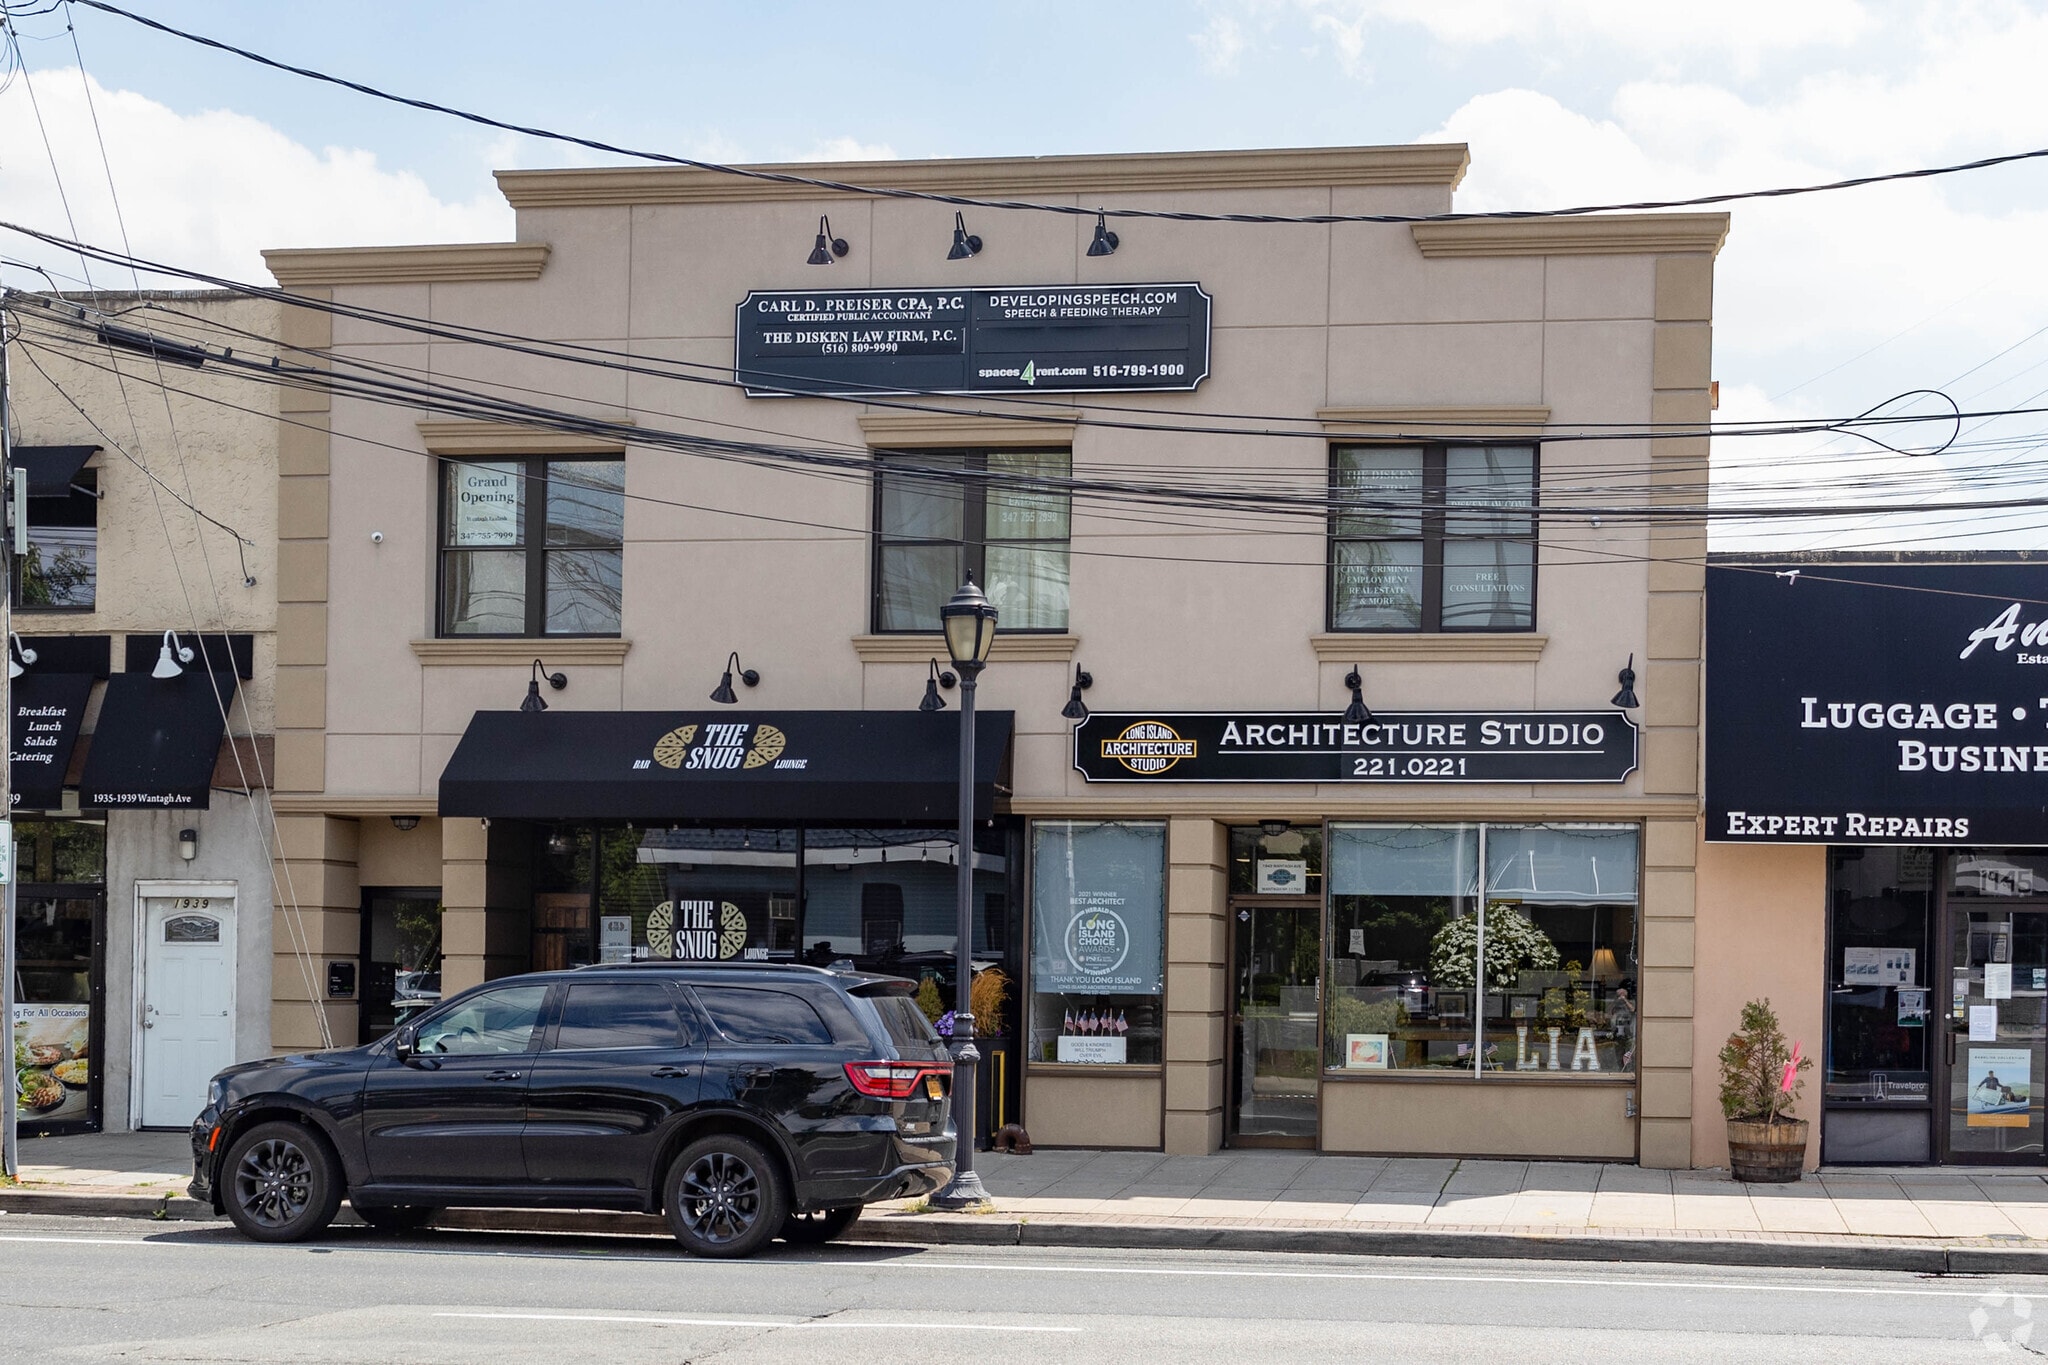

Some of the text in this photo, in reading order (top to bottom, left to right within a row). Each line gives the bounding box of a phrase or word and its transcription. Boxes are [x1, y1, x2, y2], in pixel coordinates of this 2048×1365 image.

[758, 297, 965, 313] CARL D. PREISER CPA, P.C.
[989, 292, 1177, 307] DEVELOPINGSPEECH.COM
[787, 311, 933, 322] CERTIFIED PUBLIC ACCOUNTANT
[1004, 306, 1163, 318] SPEECH & FEEDING THERAPY
[763, 330, 957, 344] THE DISKEN LAW FIRM, P.C.
[822, 342, 898, 354] (516) 809-9990
[1093, 364, 1184, 377] 516-799-1900
[468, 475, 507, 488] Grand
[461, 491, 515, 505] Opening
[460, 532, 514, 540] 347-755-7999
[1371, 565, 1414, 573] CRIMINAL
[1475, 573, 1500, 581] FREE
[1449, 584, 1525, 592] CONSULTATIONS
[17, 706, 67, 717] Breakfast
[1801, 697, 1998, 730] LUGGAGE
[28, 722, 62, 731] Lunch
[1126, 724, 1173, 739] LONG ISLAND
[703, 724, 749, 747] THE
[1219, 720, 1605, 746] ARCHITECTURE STUDIO
[24, 736, 58, 746] Salads
[1105, 742, 1193, 755] ARCHITECTURE
[8, 752, 54, 763] Catering
[685, 747, 745, 769] SNUG
[632, 759, 808, 769] BAR LOUNGE
[1130, 758, 1166, 771] STUDIO
[1353, 758, 1467, 777] 221.0221
[93, 794, 192, 805] 1935-1939 Wantagh Ave
[1727, 811, 1969, 838] EXPERT REPAIRS
[174, 898, 209, 909] 1939
[681, 900, 714, 929] THE
[1085, 906, 1110, 914] HERALD
[1078, 919, 1116, 930] LONG
[1078, 930, 1116, 938] ISLAND
[676, 930, 717, 960] SNUG
[1078, 938, 1116, 946] CHOICE
[635, 947, 769, 960] BAR LOUNGE
[1078, 945, 1116, 953] AWARDS
[1084, 967, 1111, 976] WINNER
[1091, 976, 1113, 984] LONG
[1114, 976, 1142, 984] ISLAND
[23, 1009, 35, 1017] For
[51, 1009, 87, 1017] Occasions
[1516, 1026, 1600, 1071] LIA
[1887, 1082, 1925, 1091] Travelpro
